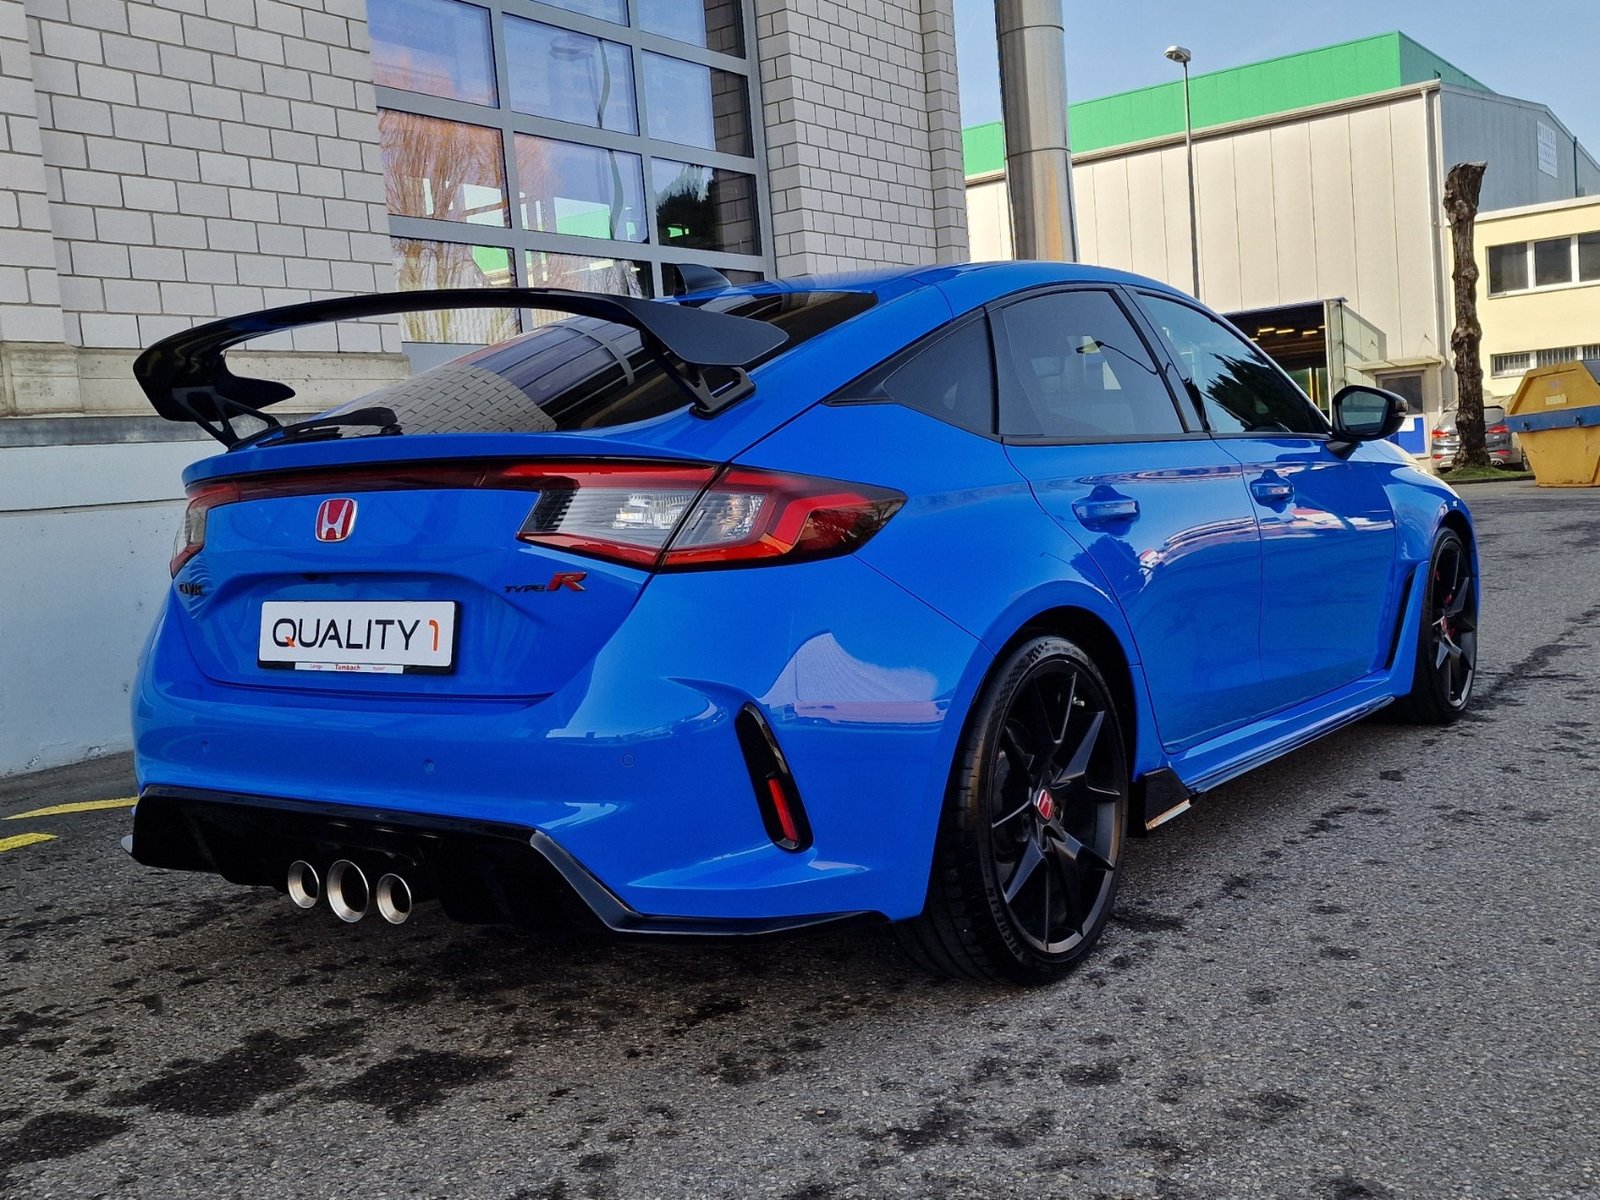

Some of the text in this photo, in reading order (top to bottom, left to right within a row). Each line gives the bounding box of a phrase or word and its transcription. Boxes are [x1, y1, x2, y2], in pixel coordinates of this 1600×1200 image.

[545, 572, 588, 592] R
[272, 617, 440, 651] QUALITY 1
